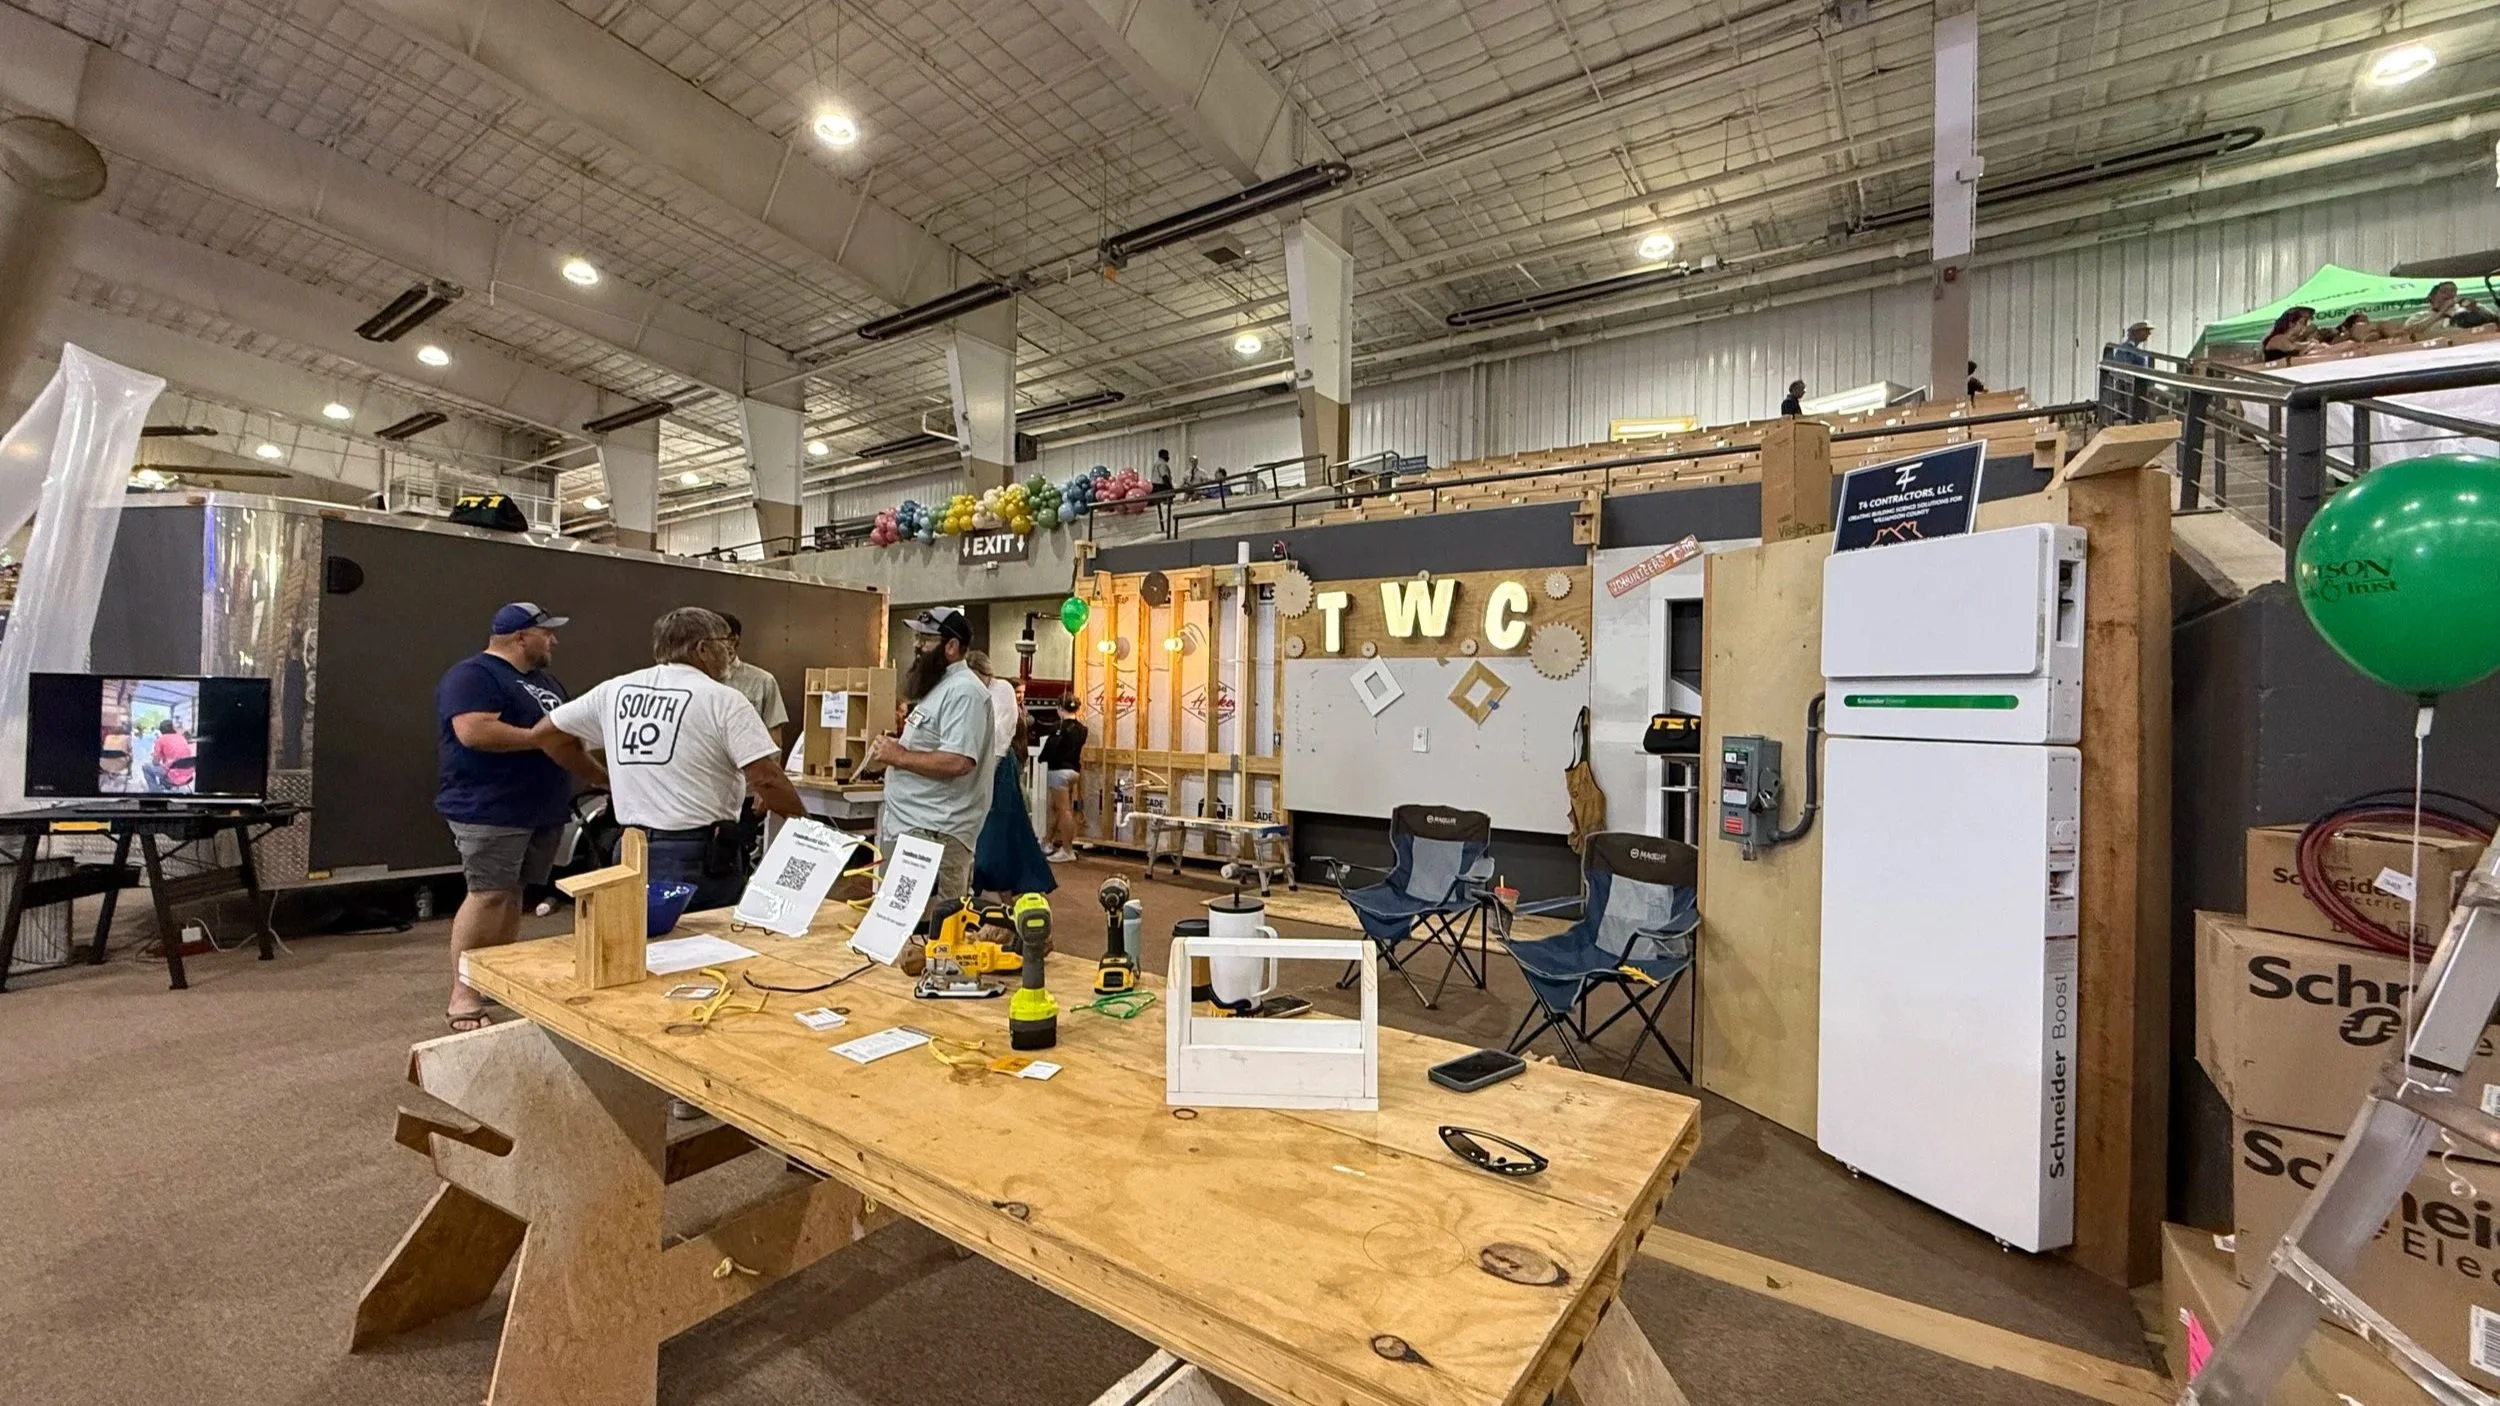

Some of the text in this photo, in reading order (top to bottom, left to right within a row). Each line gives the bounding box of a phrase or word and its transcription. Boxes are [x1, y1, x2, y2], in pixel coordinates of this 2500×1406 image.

[1869, 487, 1935, 508] CONTRACTORS,
[1937, 483, 1955, 495] LLC
[1871, 508, 1896, 518] BUILDING
[1917, 498, 1949, 509] SOLUTIONS
[1949, 495, 1963, 503] FOR
[1906, 508, 1930, 519] COUNTY
[972, 534, 1014, 556] EXIT
[1609, 556, 1667, 592] VOLUNTEERS
[2347, 581, 2396, 594] Trust
[619, 693, 679, 723] SOUTH
[622, 722, 660, 755] 40
[2049, 974, 2068, 1180] Schneider Boost
